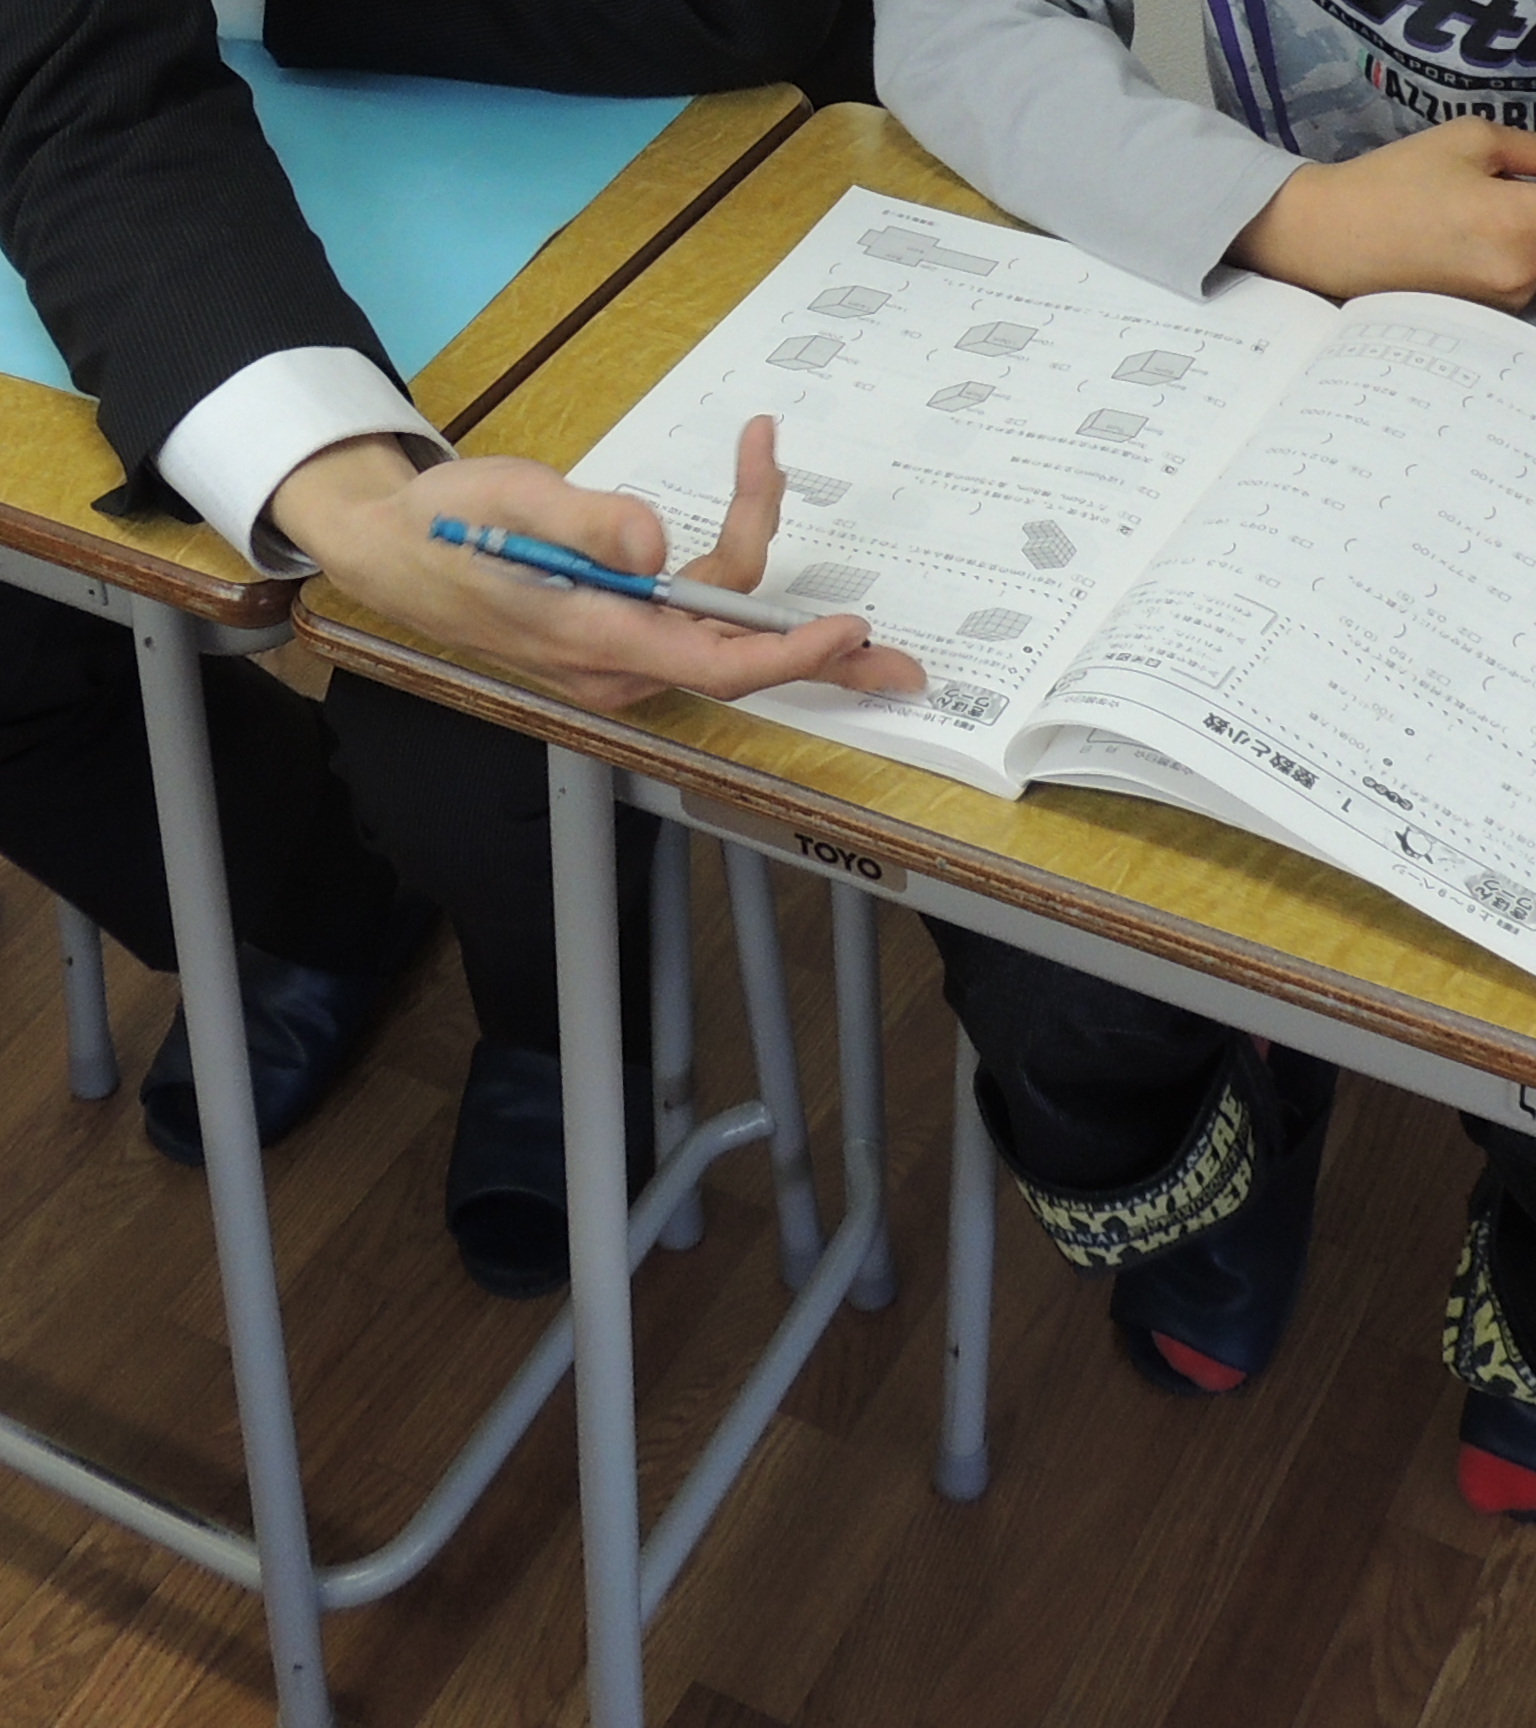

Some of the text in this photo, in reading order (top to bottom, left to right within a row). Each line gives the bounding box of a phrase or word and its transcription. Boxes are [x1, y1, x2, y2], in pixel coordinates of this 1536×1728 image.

[1393, 52, 1474, 89] SPORT
[936, 694, 986, 720] きほん
[944, 687, 992, 710] ワーク
[1202, 712, 1320, 792] 整数と小数
[794, 832, 883, 880] TOYO
[1474, 885, 1530, 922] きほん
[1481, 878, 1534, 911] ワーク
